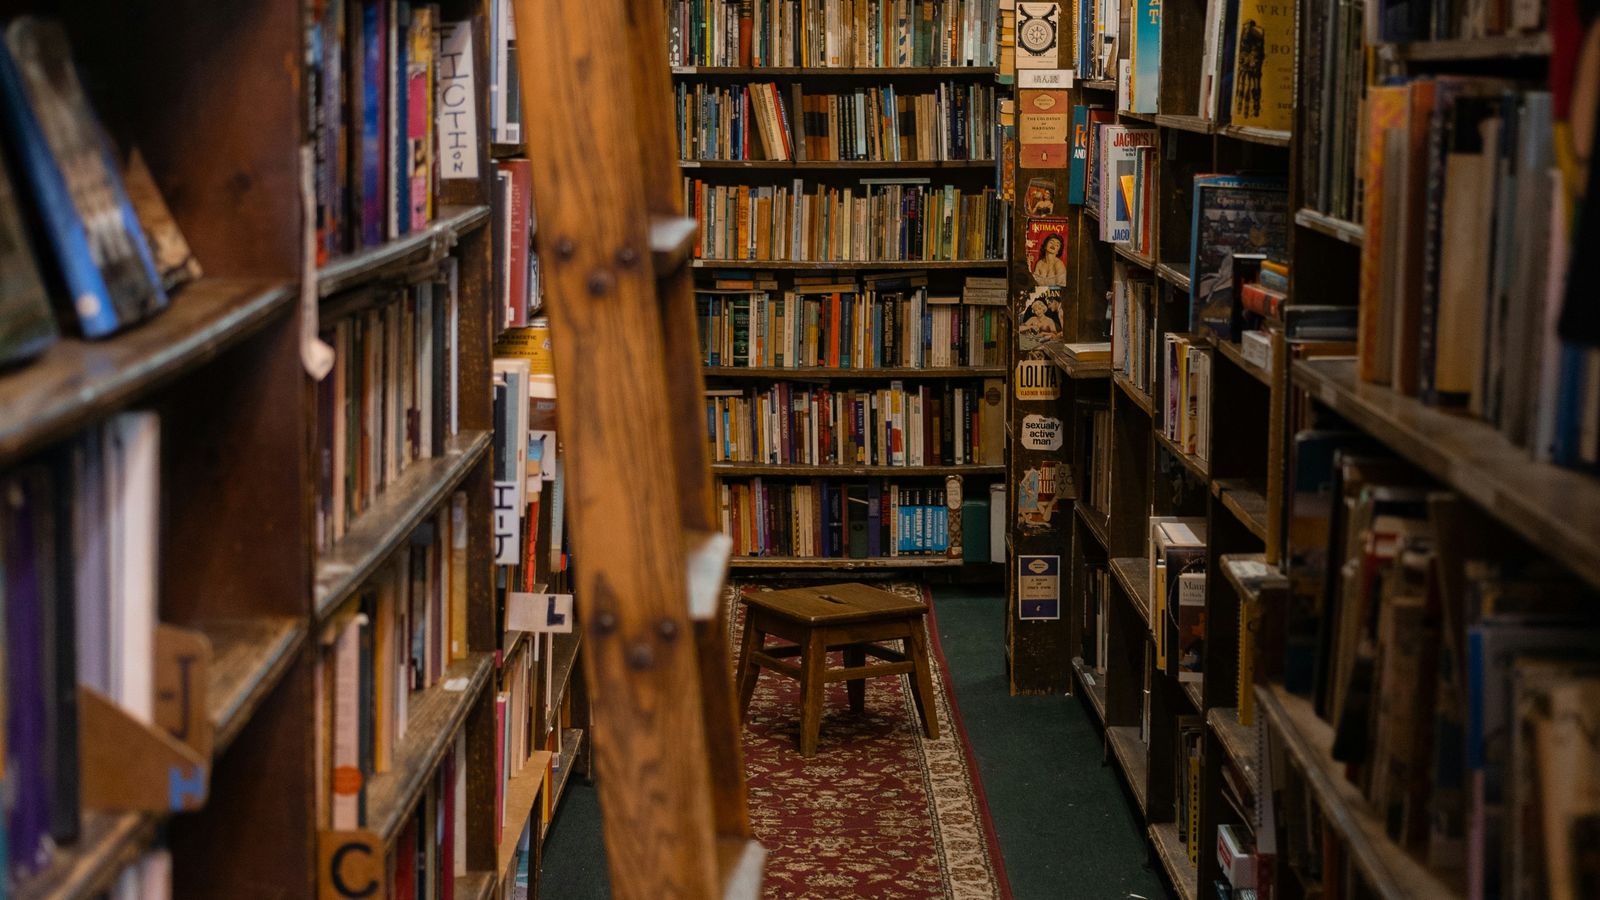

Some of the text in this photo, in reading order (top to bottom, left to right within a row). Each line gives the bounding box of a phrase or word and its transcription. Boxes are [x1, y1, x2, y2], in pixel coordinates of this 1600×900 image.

[433, 24, 470, 173] FICTION
[1113, 132, 1149, 148] JACOB'S
[1073, 148, 1086, 159] AND
[1031, 224, 1065, 233] INTIMACY
[1112, 228, 1130, 241] JACO
[1020, 365, 1057, 388] LOLITA
[1025, 422, 1060, 431] sexually
[916, 538, 923, 547] IV
[547, 596, 565, 626] L
[331, 842, 378, 898] C
